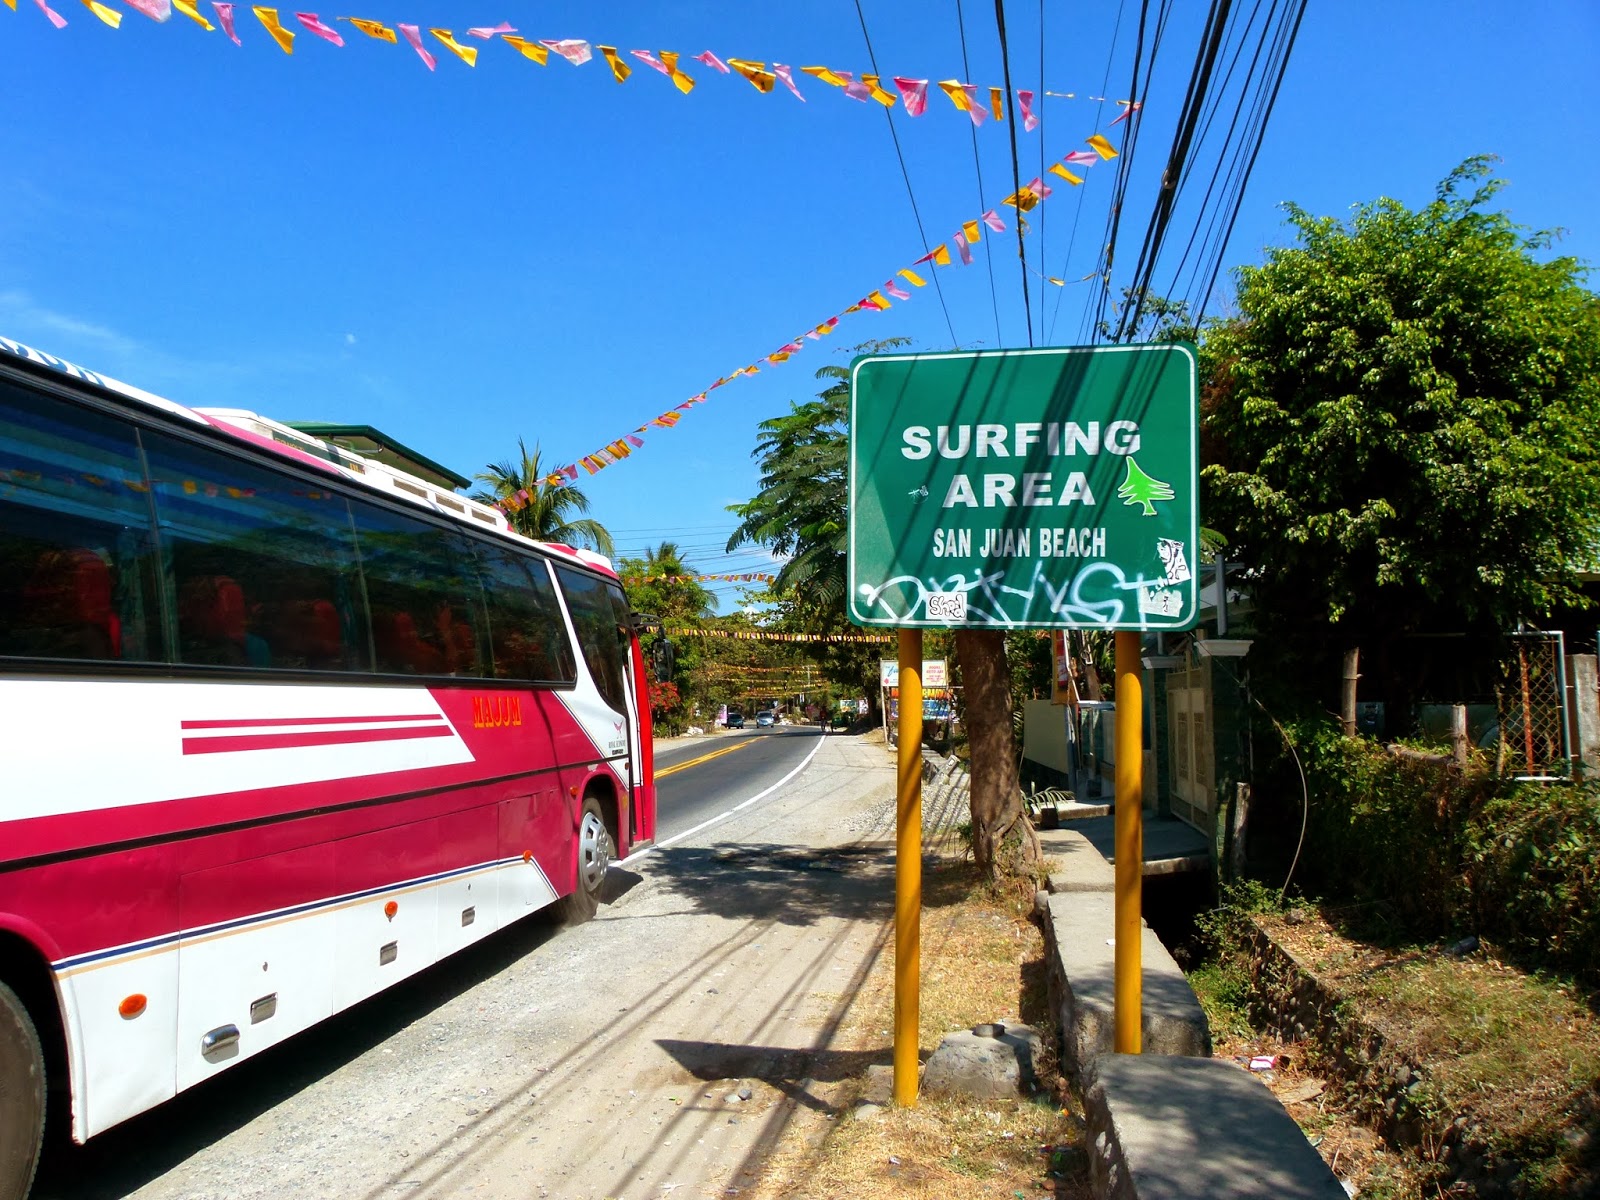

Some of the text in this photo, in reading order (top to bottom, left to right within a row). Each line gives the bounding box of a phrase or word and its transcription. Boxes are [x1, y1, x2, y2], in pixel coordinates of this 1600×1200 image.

[901, 420, 1141, 460] SURFING
[942, 471, 1096, 508] AREA
[932, 528, 1106, 558] SAN JUAN BEACH
